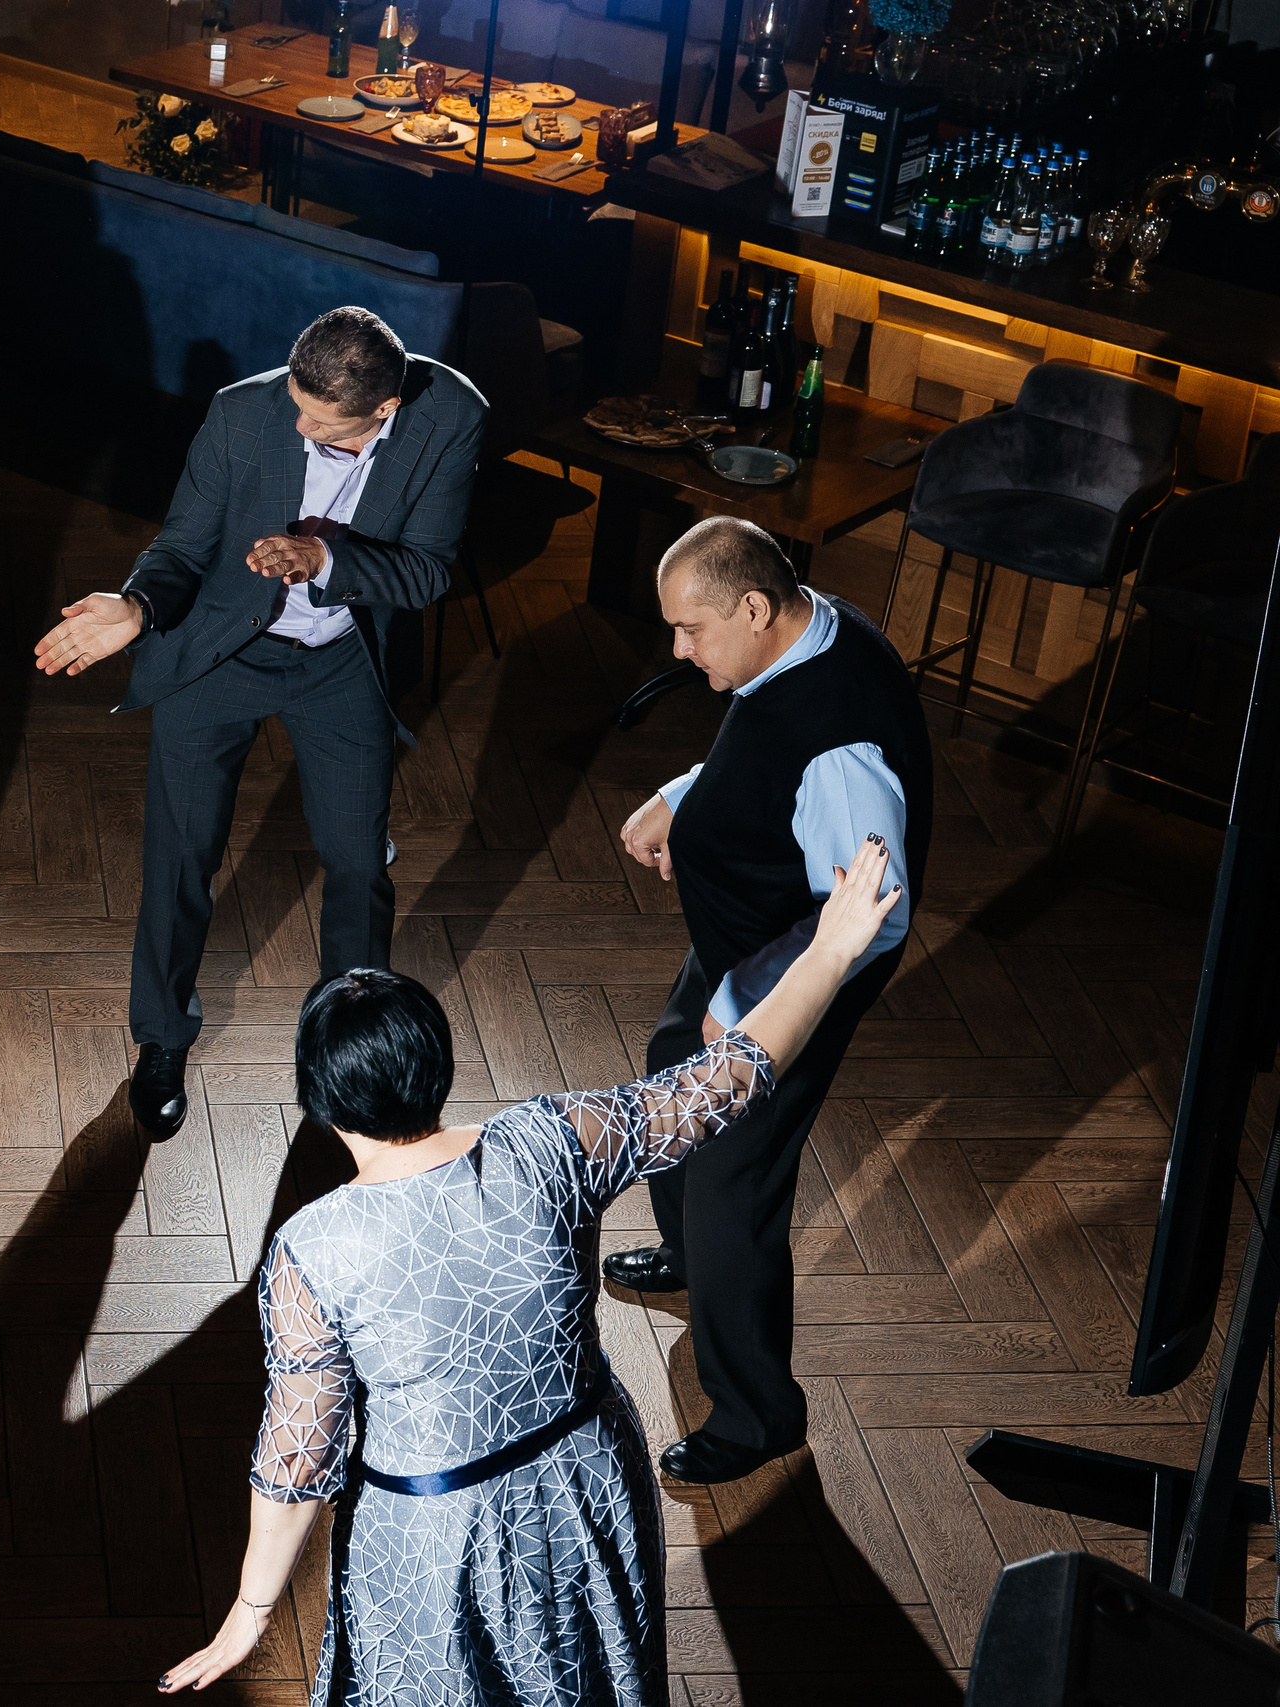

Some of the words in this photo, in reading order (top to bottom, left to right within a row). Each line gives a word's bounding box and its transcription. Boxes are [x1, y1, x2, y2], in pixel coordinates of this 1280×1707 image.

[828, 97, 853, 111] Бери
[854, 105, 887, 121] заряд!
[808, 130, 839, 139] СКИДКА
